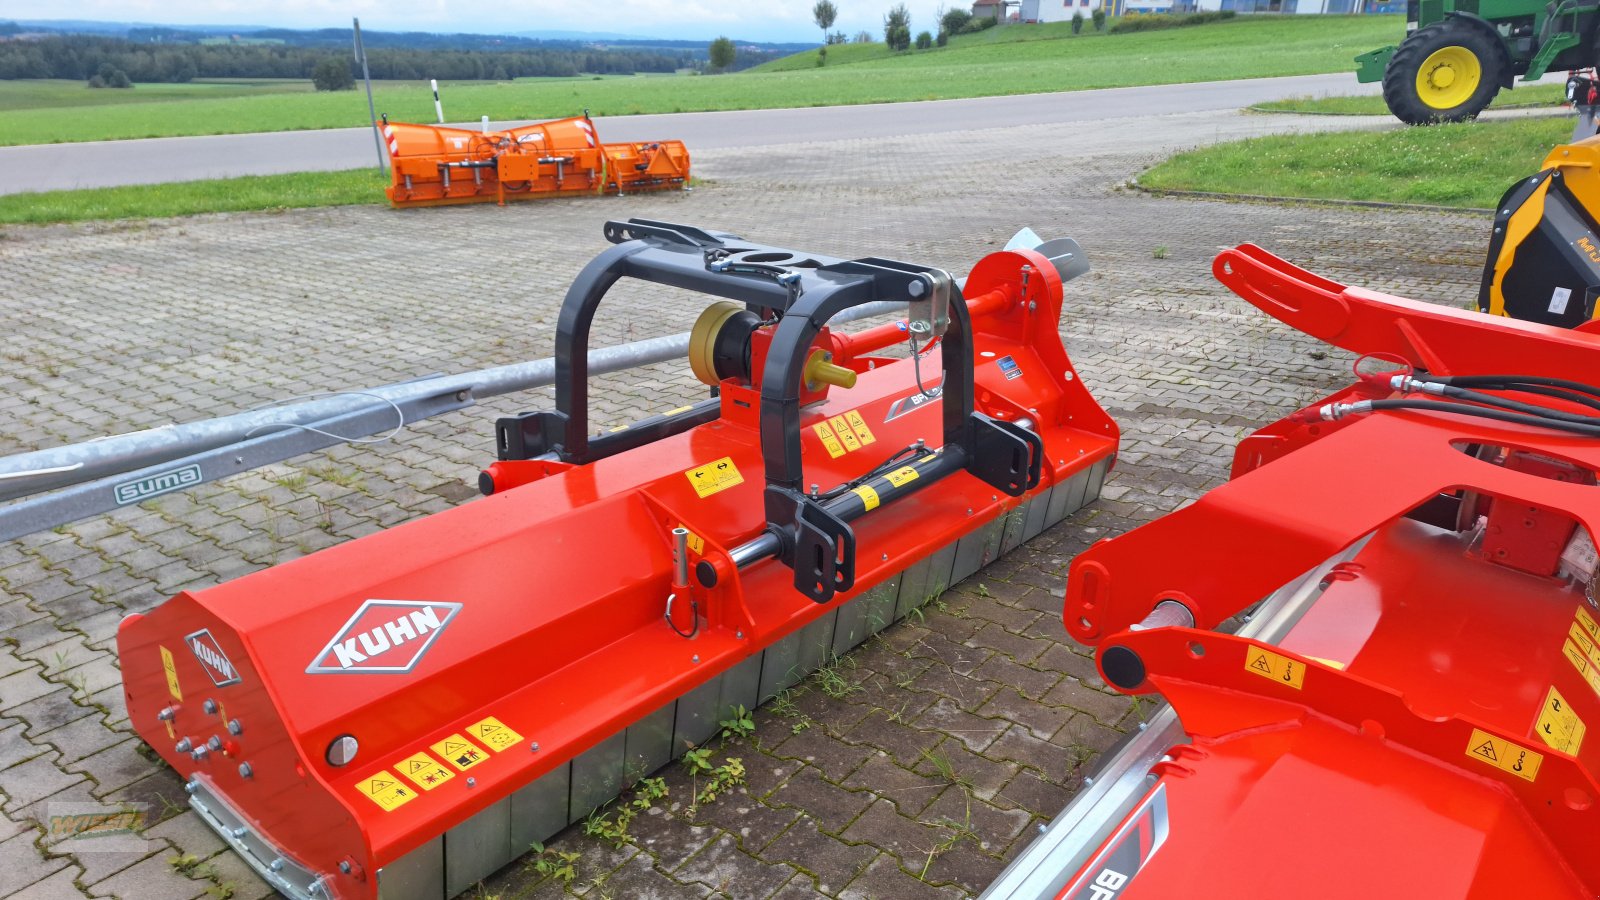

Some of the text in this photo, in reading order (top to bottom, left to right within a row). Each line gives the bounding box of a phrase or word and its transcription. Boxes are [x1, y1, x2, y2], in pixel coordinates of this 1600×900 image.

[120, 469, 197, 500] suma
[192, 637, 233, 680] KUHN
[332, 605, 441, 669] KUHN
